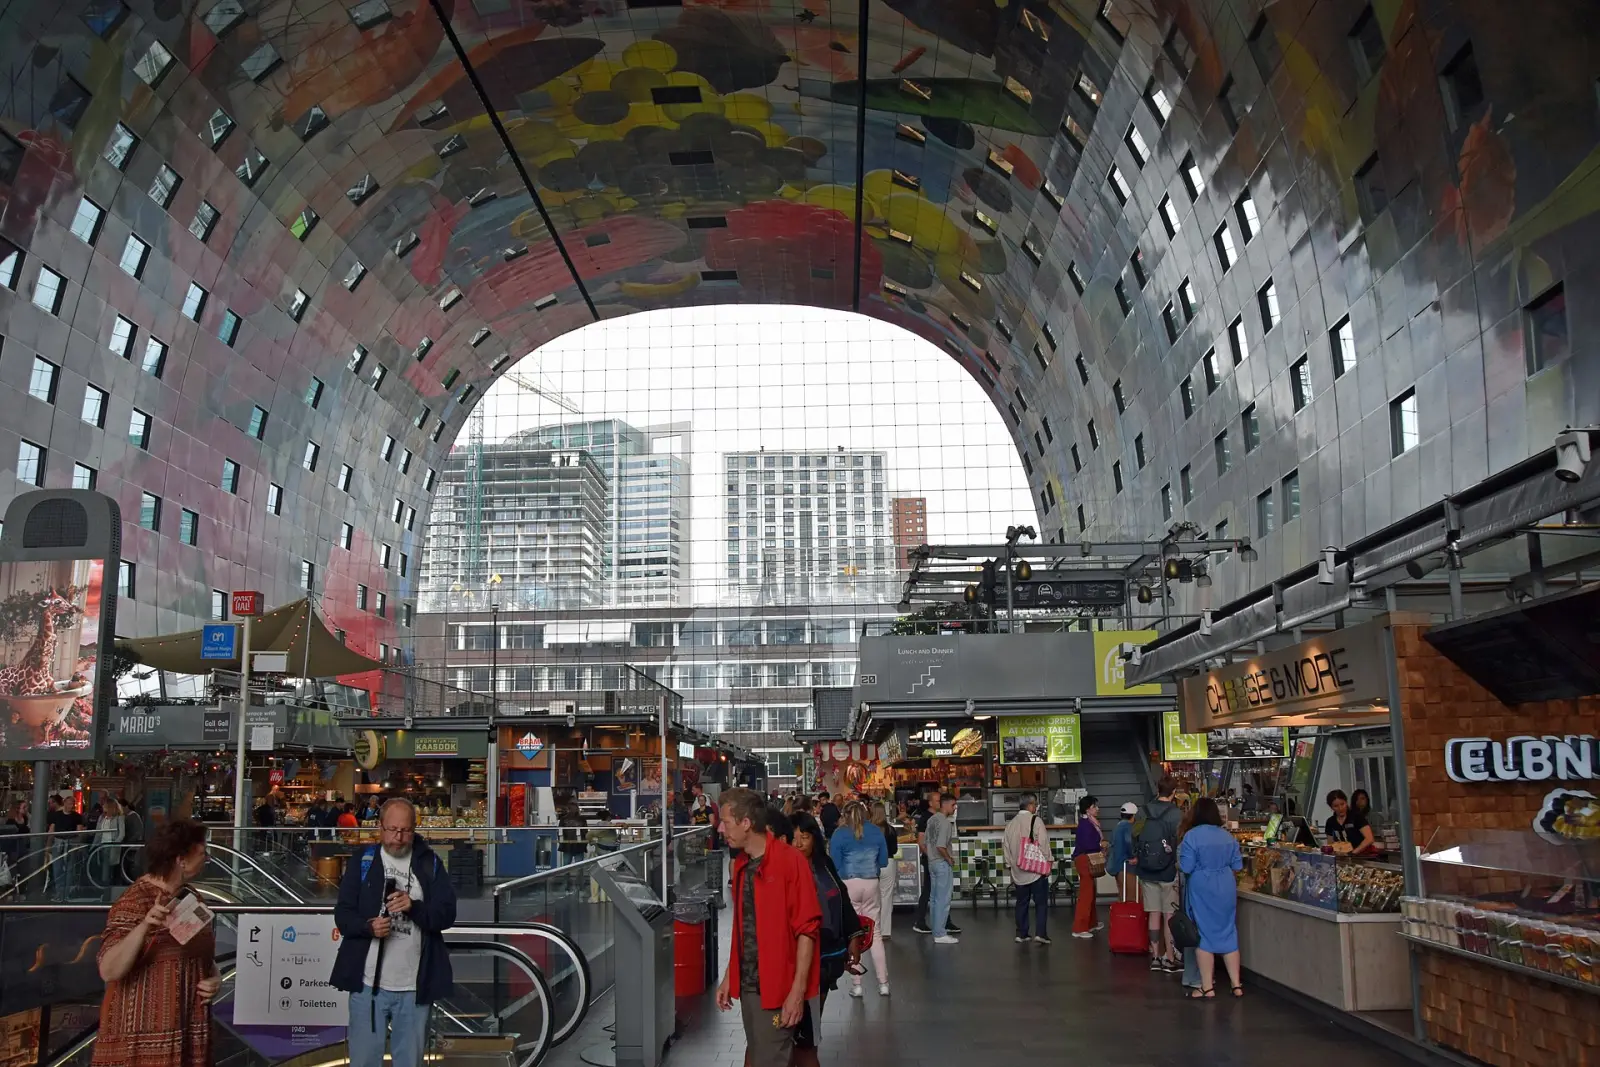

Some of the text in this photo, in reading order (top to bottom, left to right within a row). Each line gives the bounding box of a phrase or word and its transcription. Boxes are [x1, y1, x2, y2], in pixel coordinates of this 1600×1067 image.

[1270, 667, 1286, 699] &
[1283, 648, 1353, 697] MORE
[120, 716, 161, 733] MARIO'S
[1004, 718, 1023, 726] YOU
[1048, 717, 1076, 725] ORDER
[924, 729, 947, 742] PIDE
[1048, 726, 1072, 734] TABLE
[1458, 738, 1597, 781] ELBN
[270, 772, 282, 783] illy
